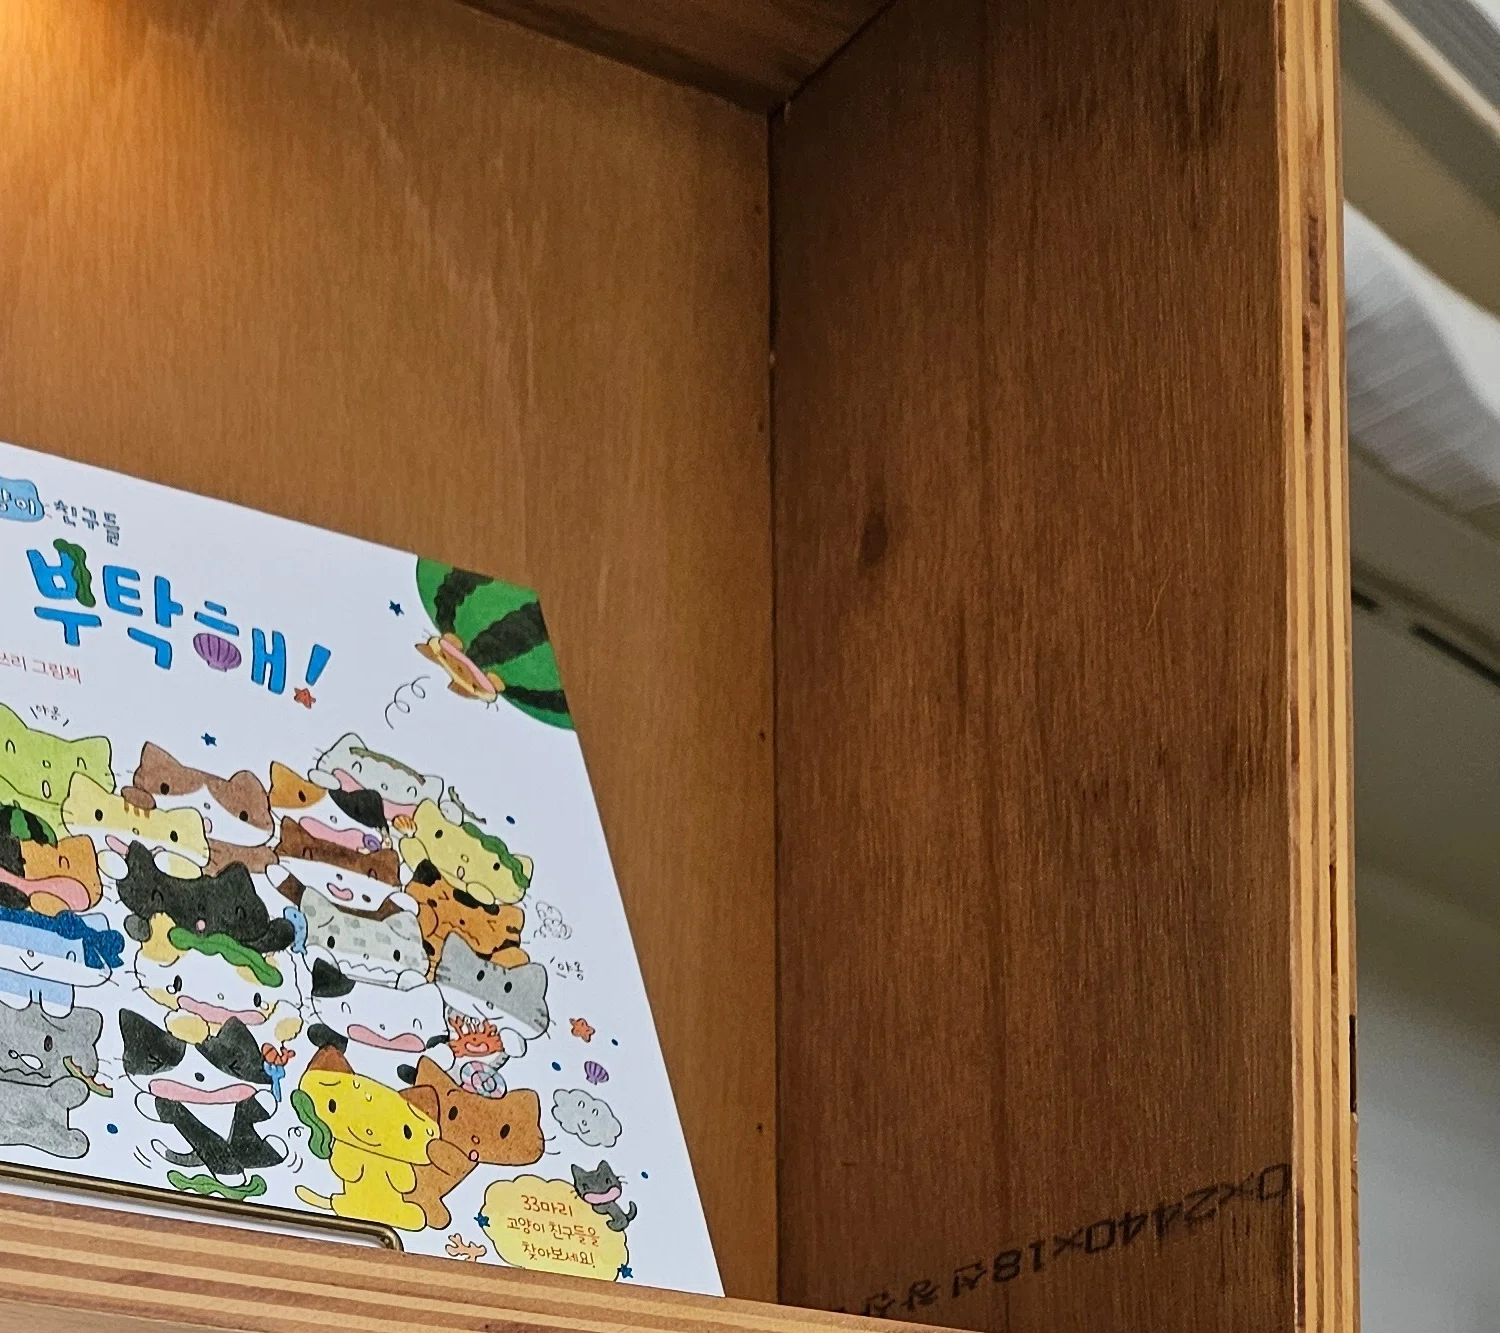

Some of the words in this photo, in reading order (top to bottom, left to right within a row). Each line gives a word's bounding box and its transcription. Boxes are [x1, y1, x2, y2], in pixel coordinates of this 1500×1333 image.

[54, 499, 120, 546] 친구들
[32, 659, 81, 684] 그림책
[521, 1194, 573, 1217] 33마리
[507, 1217, 545, 1235] 고양이
[549, 1221, 600, 1248] 친구들을
[522, 1240, 596, 1269] 찾아보세요!
